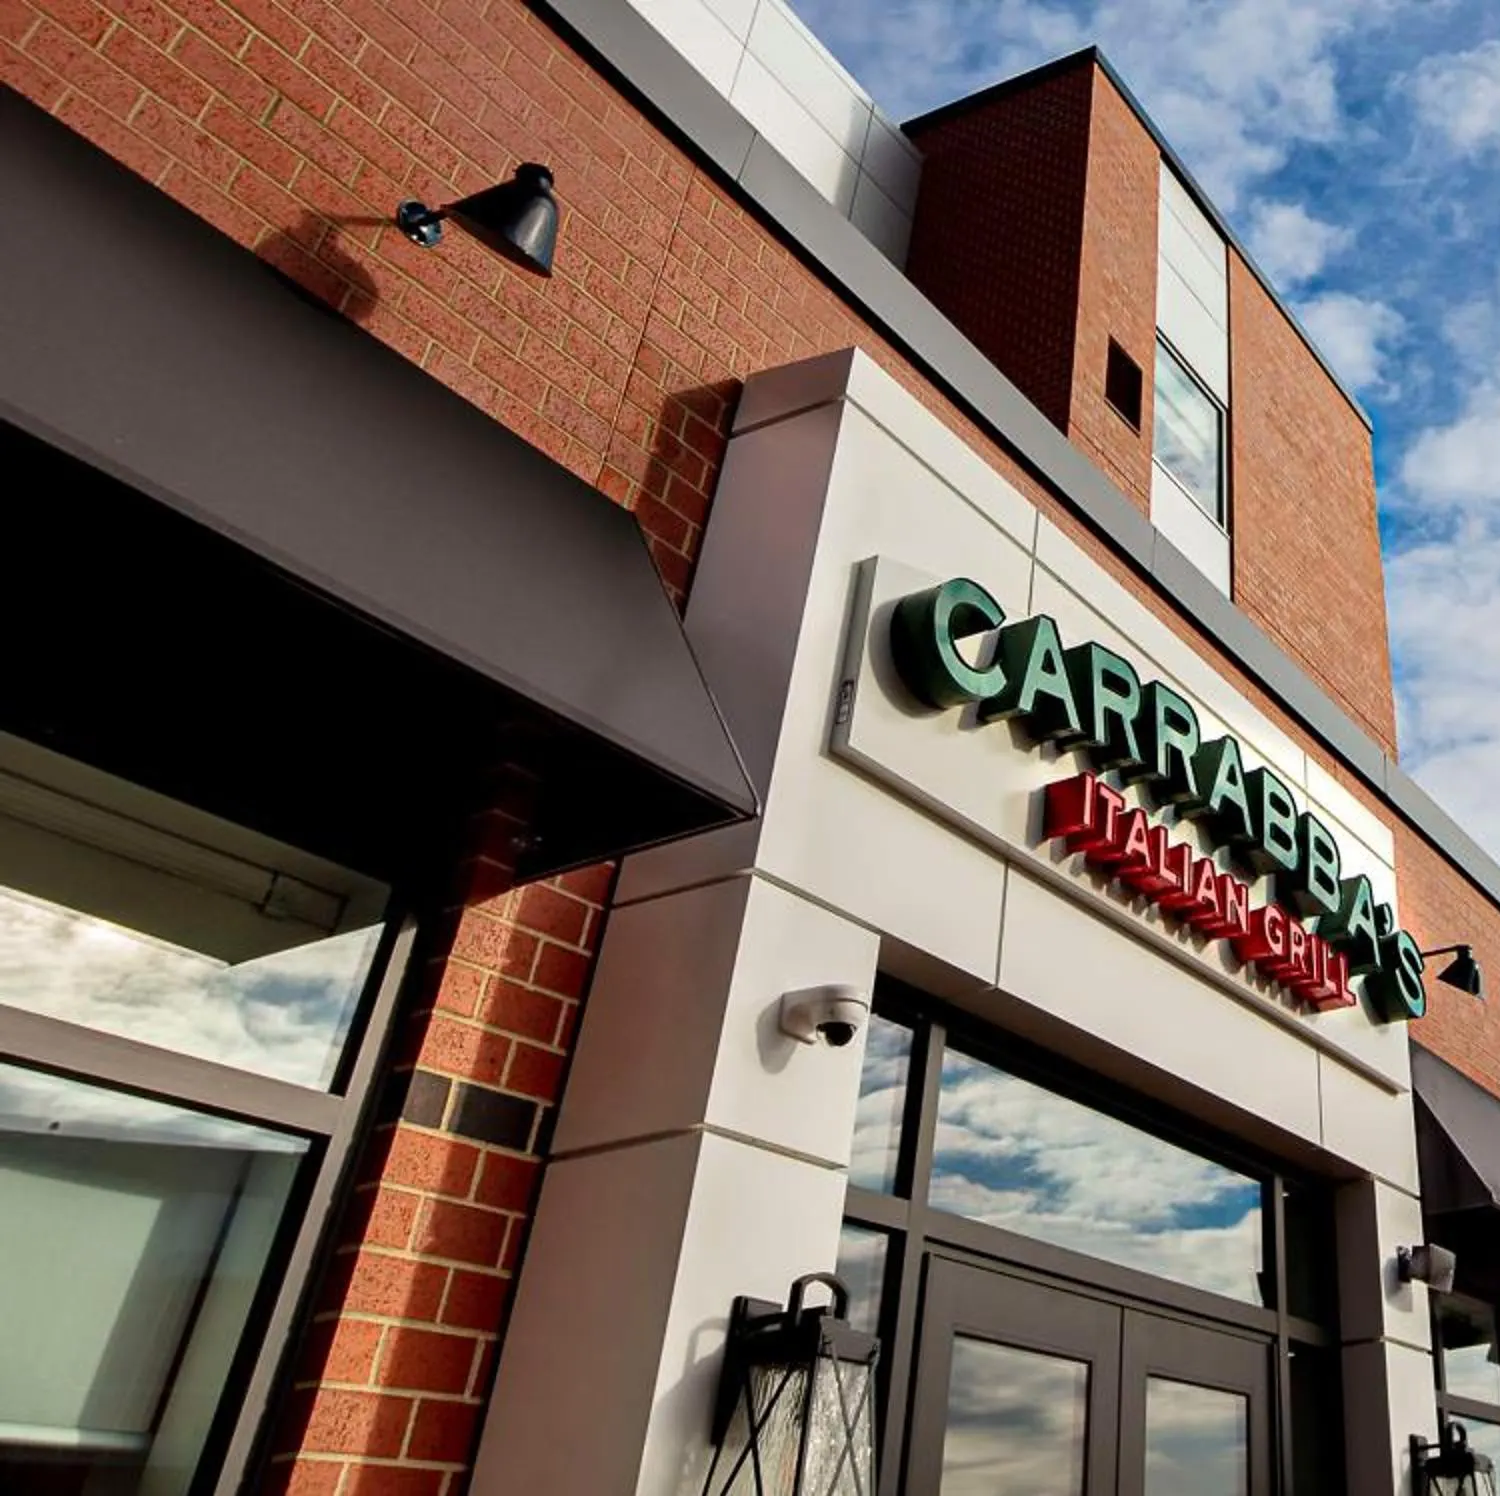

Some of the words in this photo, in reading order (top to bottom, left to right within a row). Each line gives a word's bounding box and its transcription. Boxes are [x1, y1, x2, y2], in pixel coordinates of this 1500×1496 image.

[928, 577, 1426, 1019] CARRABBA'S
[1079, 770, 1251, 938] ITALIAN
[1259, 903, 1356, 1007] GRILL
